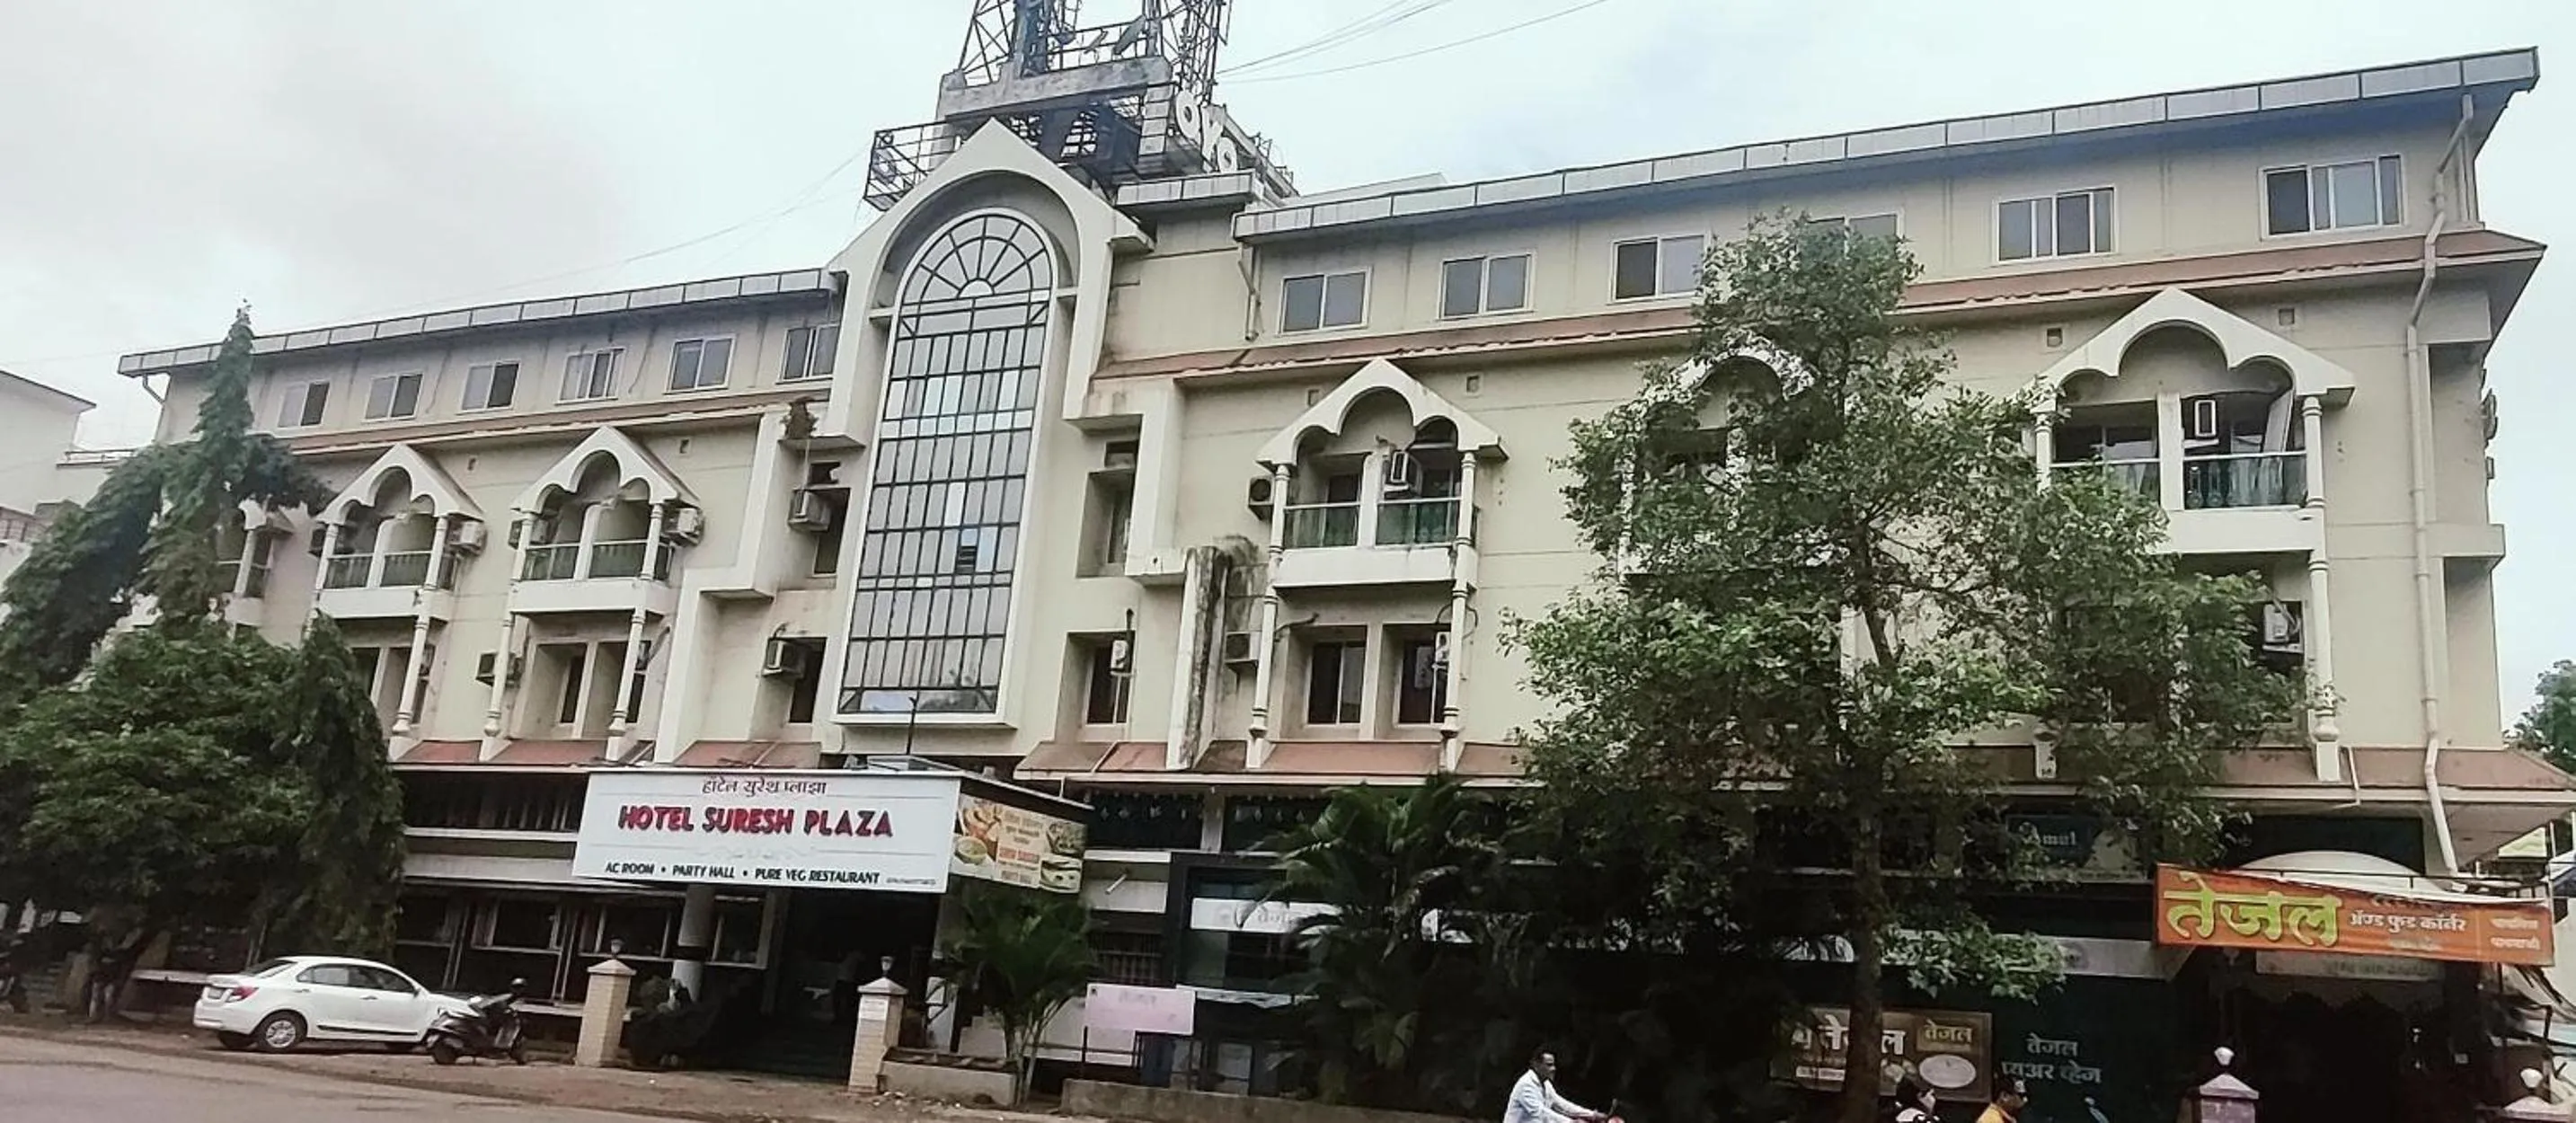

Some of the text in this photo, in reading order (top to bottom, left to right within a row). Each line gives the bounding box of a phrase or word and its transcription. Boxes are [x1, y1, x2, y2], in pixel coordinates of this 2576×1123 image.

[618, 805, 893, 837] HOTEL SURESH PLAZA
[605, 862, 621, 873] AC
[622, 862, 654, 875] ROOM
[672, 864, 707, 877] PARTY
[708, 866, 735, 878] HALL
[755, 868, 783, 880] PURE
[786, 869, 807, 881] VEG
[809, 870, 881, 884] RESTAURANT
[2164, 871, 2342, 948] तेजल
